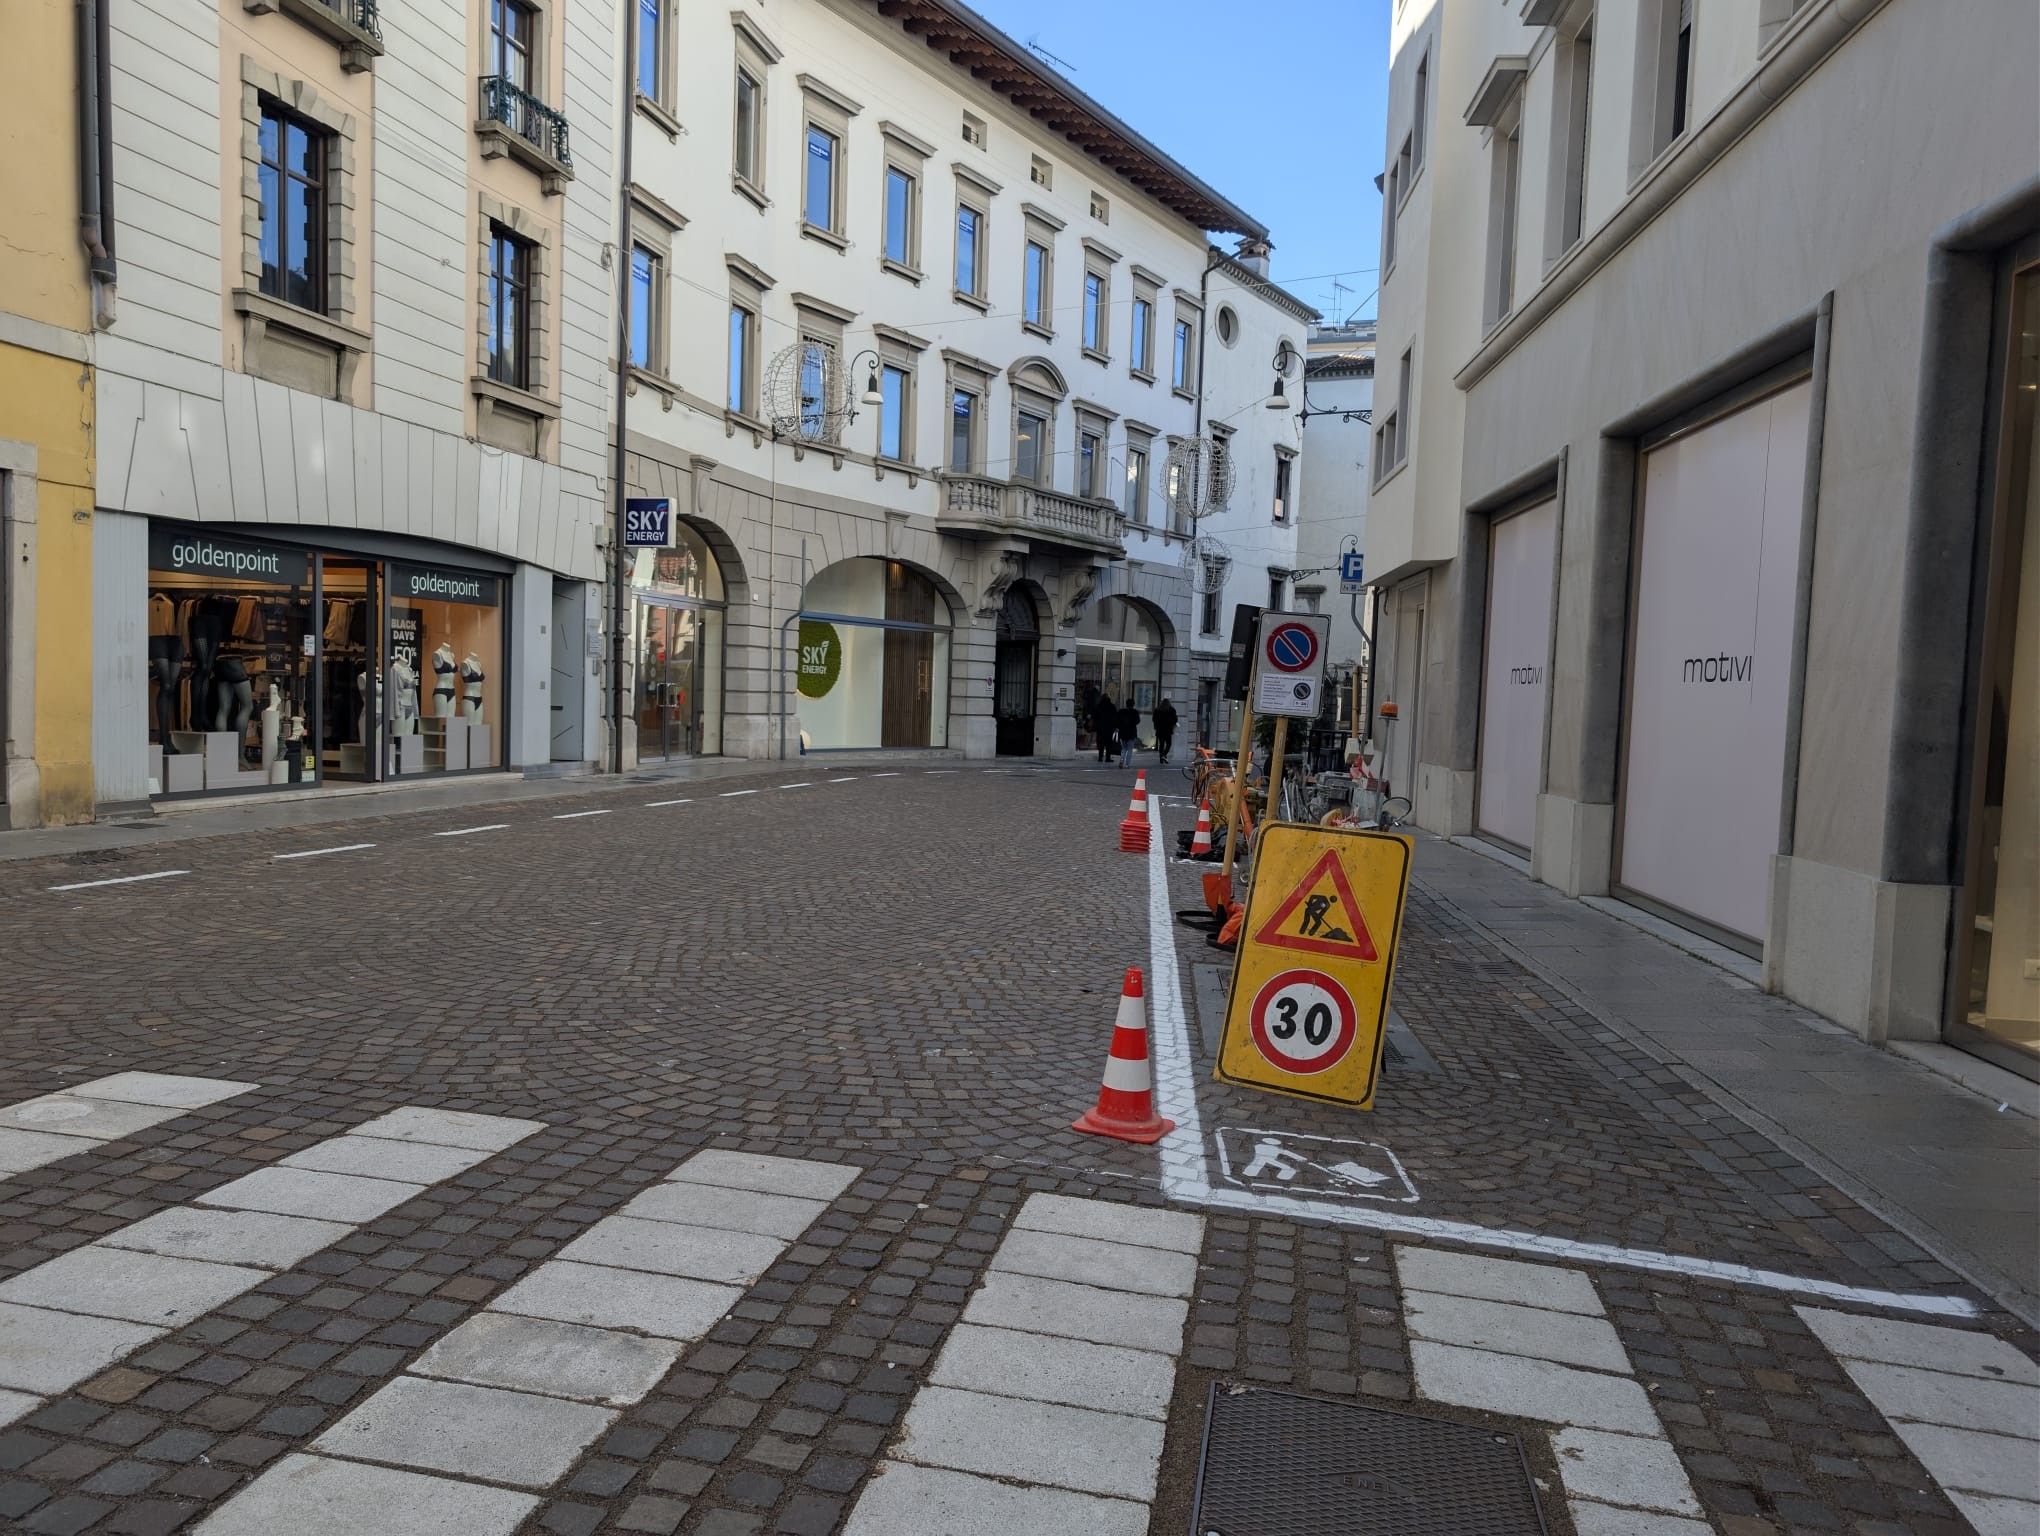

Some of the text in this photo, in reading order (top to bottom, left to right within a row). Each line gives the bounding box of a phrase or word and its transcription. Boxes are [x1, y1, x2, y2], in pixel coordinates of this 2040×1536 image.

[627, 510, 665, 531] SKY
[626, 531, 665, 542] ENERGY
[172, 540, 280, 574] goldenpoint
[1348, 557, 1363, 577] P
[411, 571, 480, 599] goldenpoint
[391, 618, 417, 631] BLACK
[393, 630, 415, 641] DAYS
[802, 645, 828, 665] SKY
[802, 664, 827, 675] ENERGY
[1511, 664, 1543, 685] motivi
[1683, 651, 1752, 683] motivi
[1272, 996, 1333, 1046] 30
[1343, 1475, 1394, 1493] ENEL
